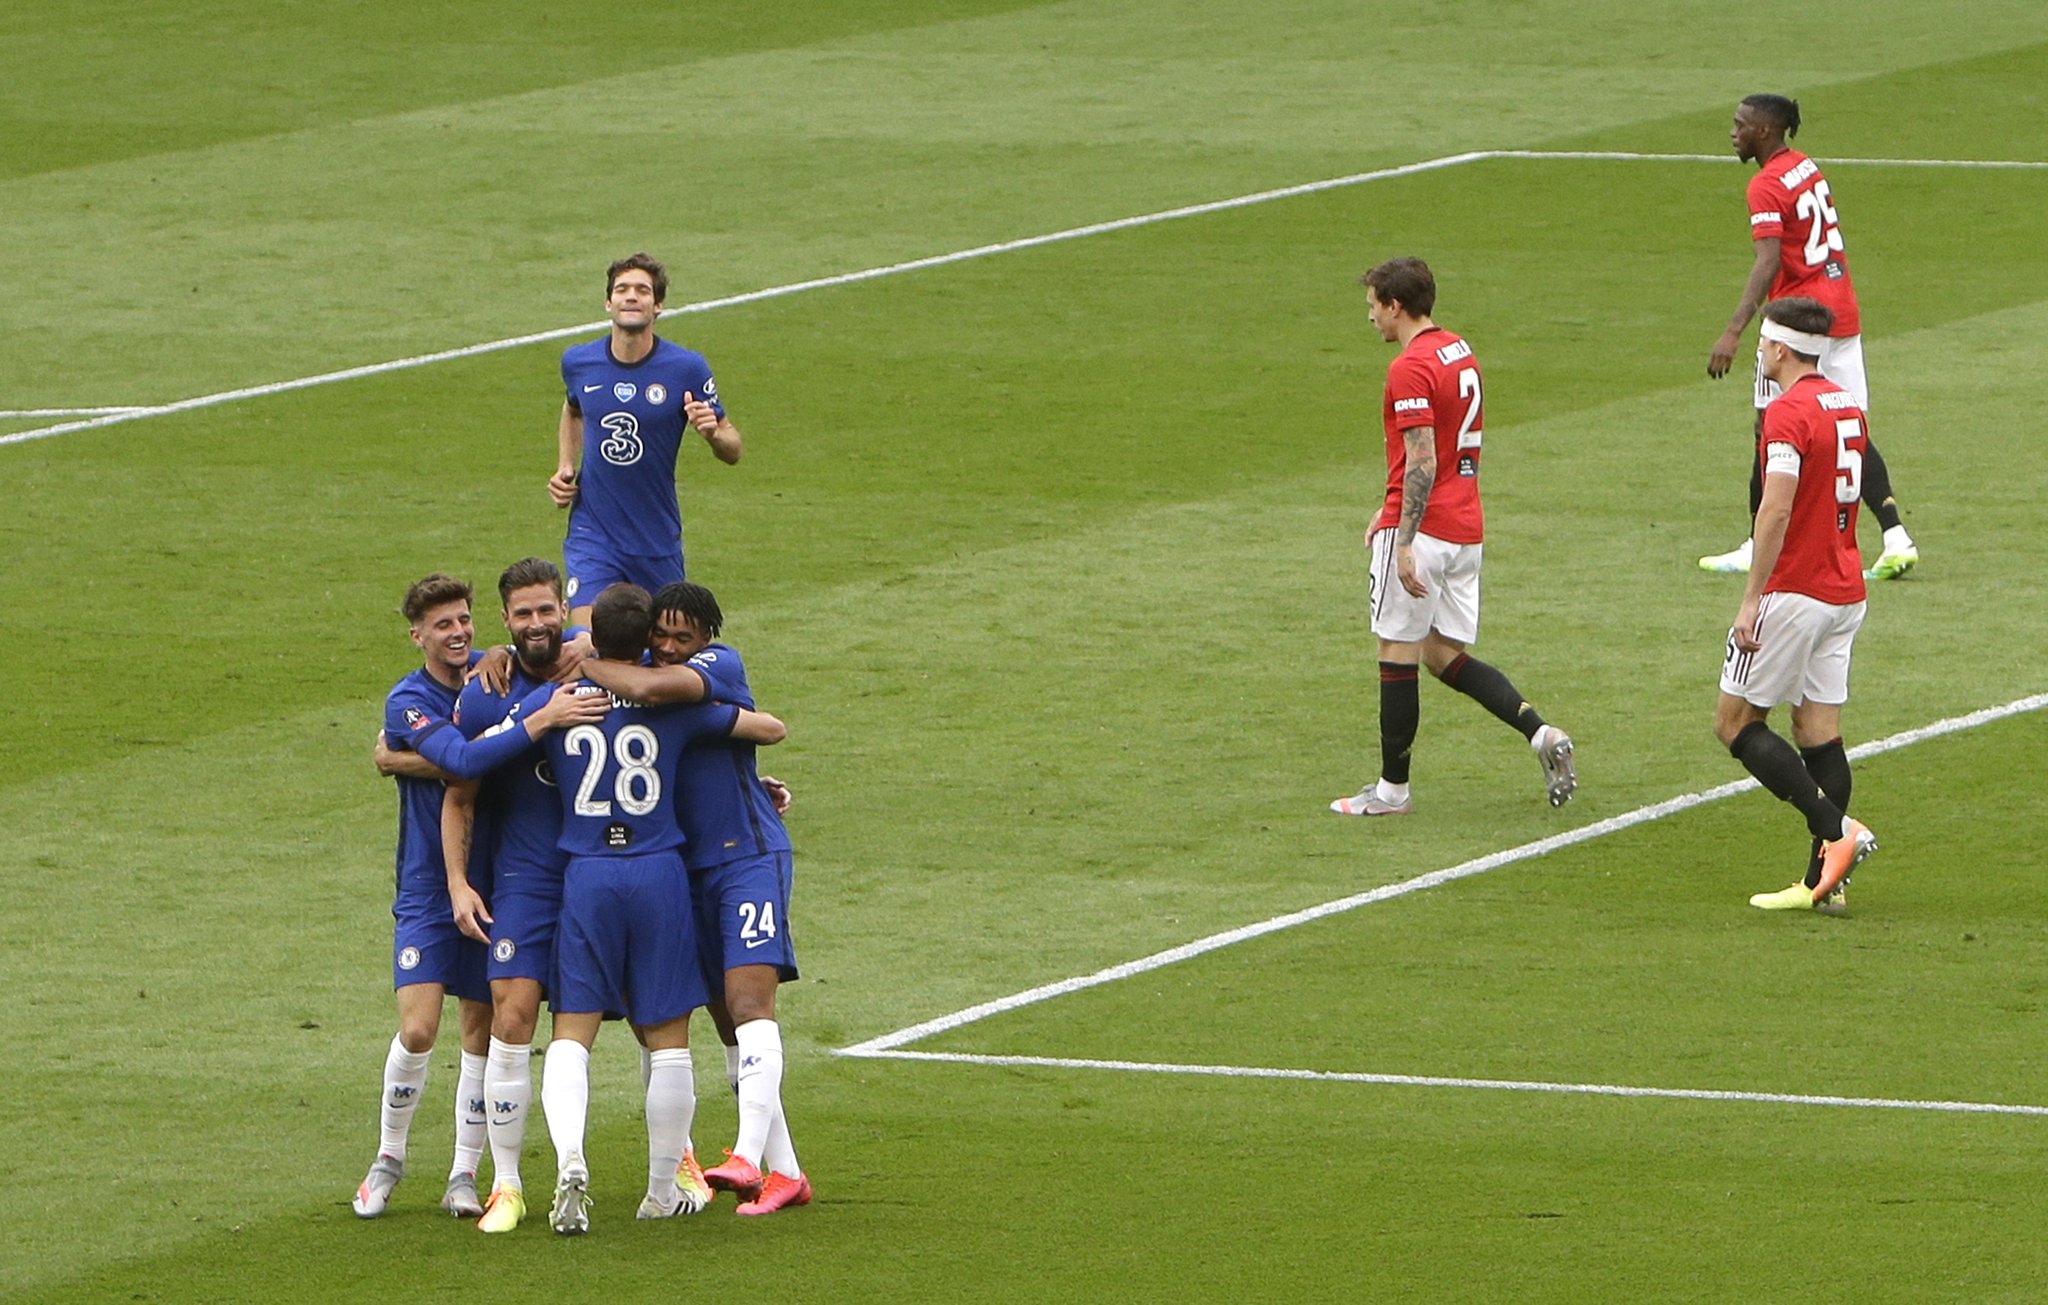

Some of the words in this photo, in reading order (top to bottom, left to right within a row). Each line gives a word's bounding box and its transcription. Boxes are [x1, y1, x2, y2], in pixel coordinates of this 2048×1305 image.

[1795, 179, 1844, 266] 25
[601, 411, 643, 466] 3
[1457, 367, 1482, 451] 2
[1835, 417, 1862, 503] 5
[563, 724, 661, 816] 28
[739, 901, 776, 938] 24
